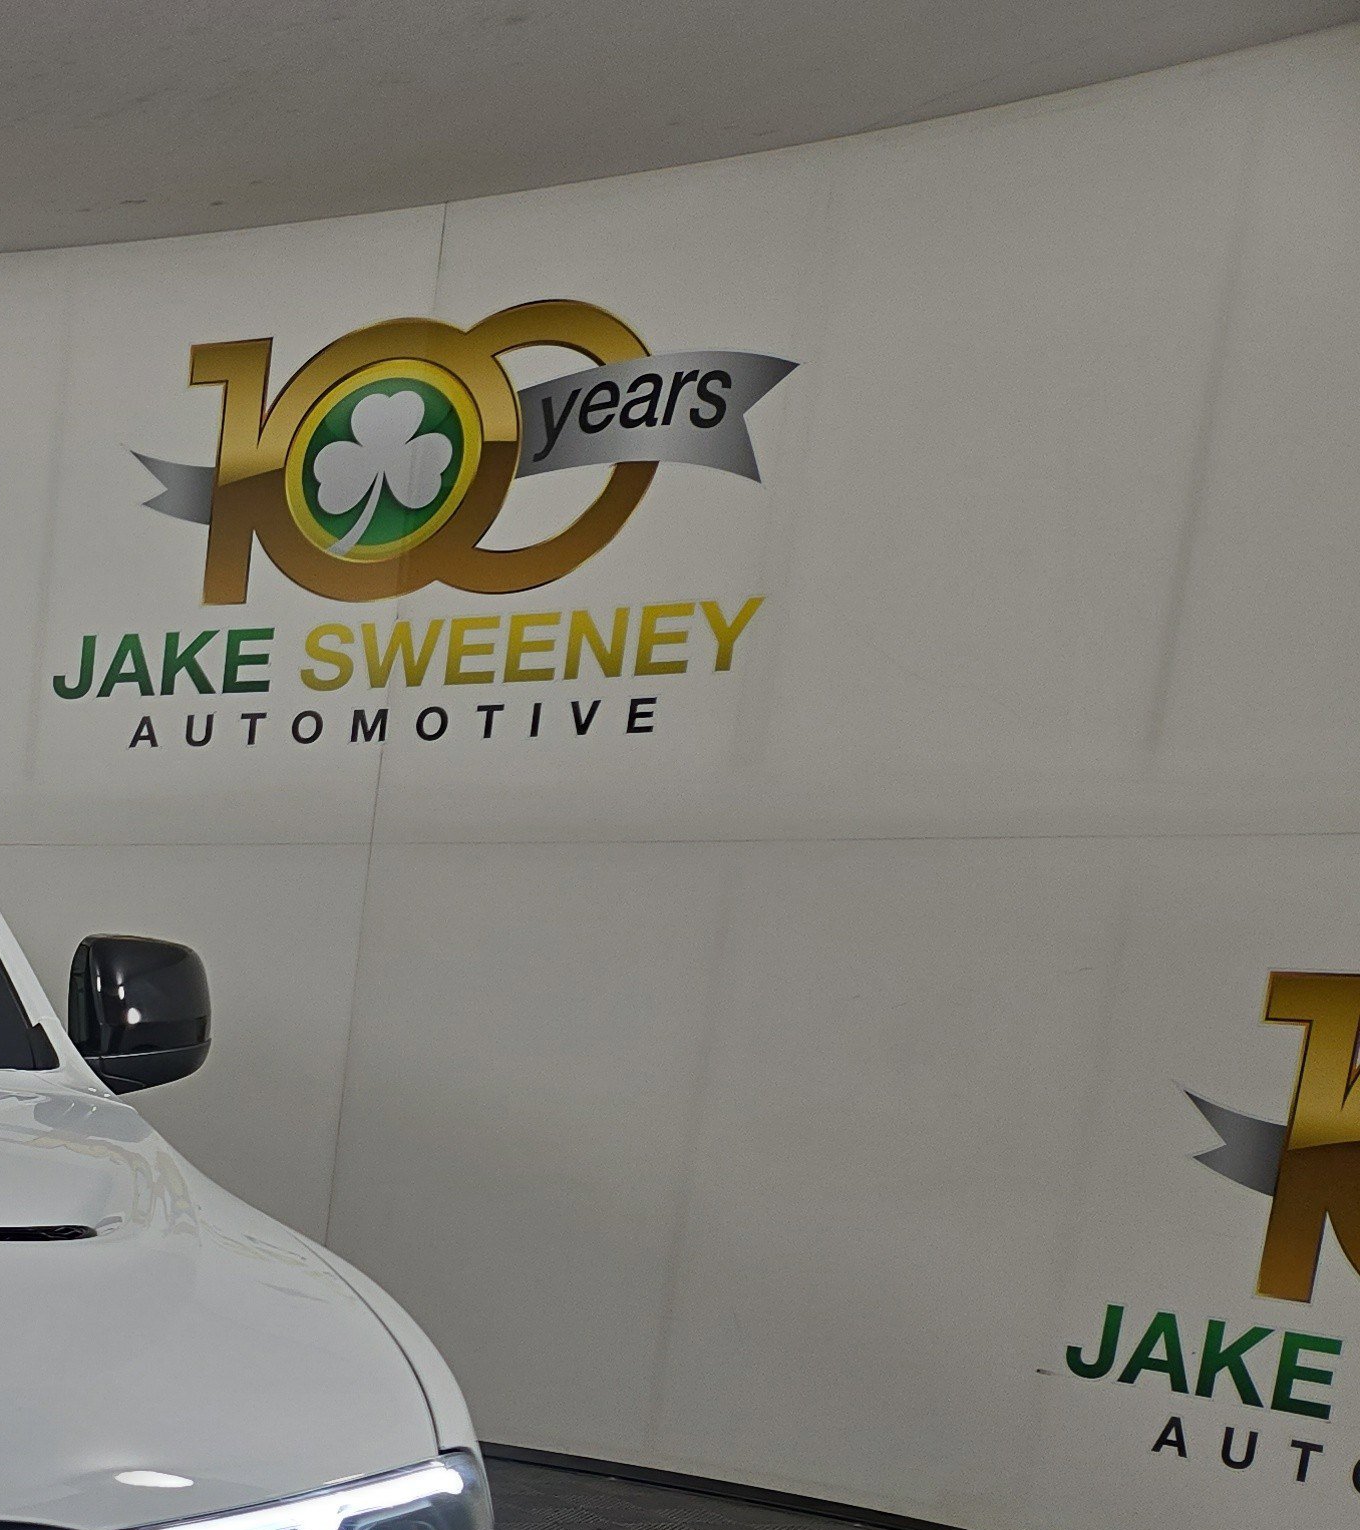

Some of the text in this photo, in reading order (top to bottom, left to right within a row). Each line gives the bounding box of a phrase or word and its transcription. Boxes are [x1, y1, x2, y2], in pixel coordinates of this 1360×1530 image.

[190, 298, 662, 605] 100
[533, 369, 732, 462] years
[52, 597, 766, 700] JAKE SWEENEY
[129, 697, 659, 748] AUTOMOTIVE
[1065, 1303, 1344, 1421] JAKE
[1151, 1416, 1360, 1494] AUT
